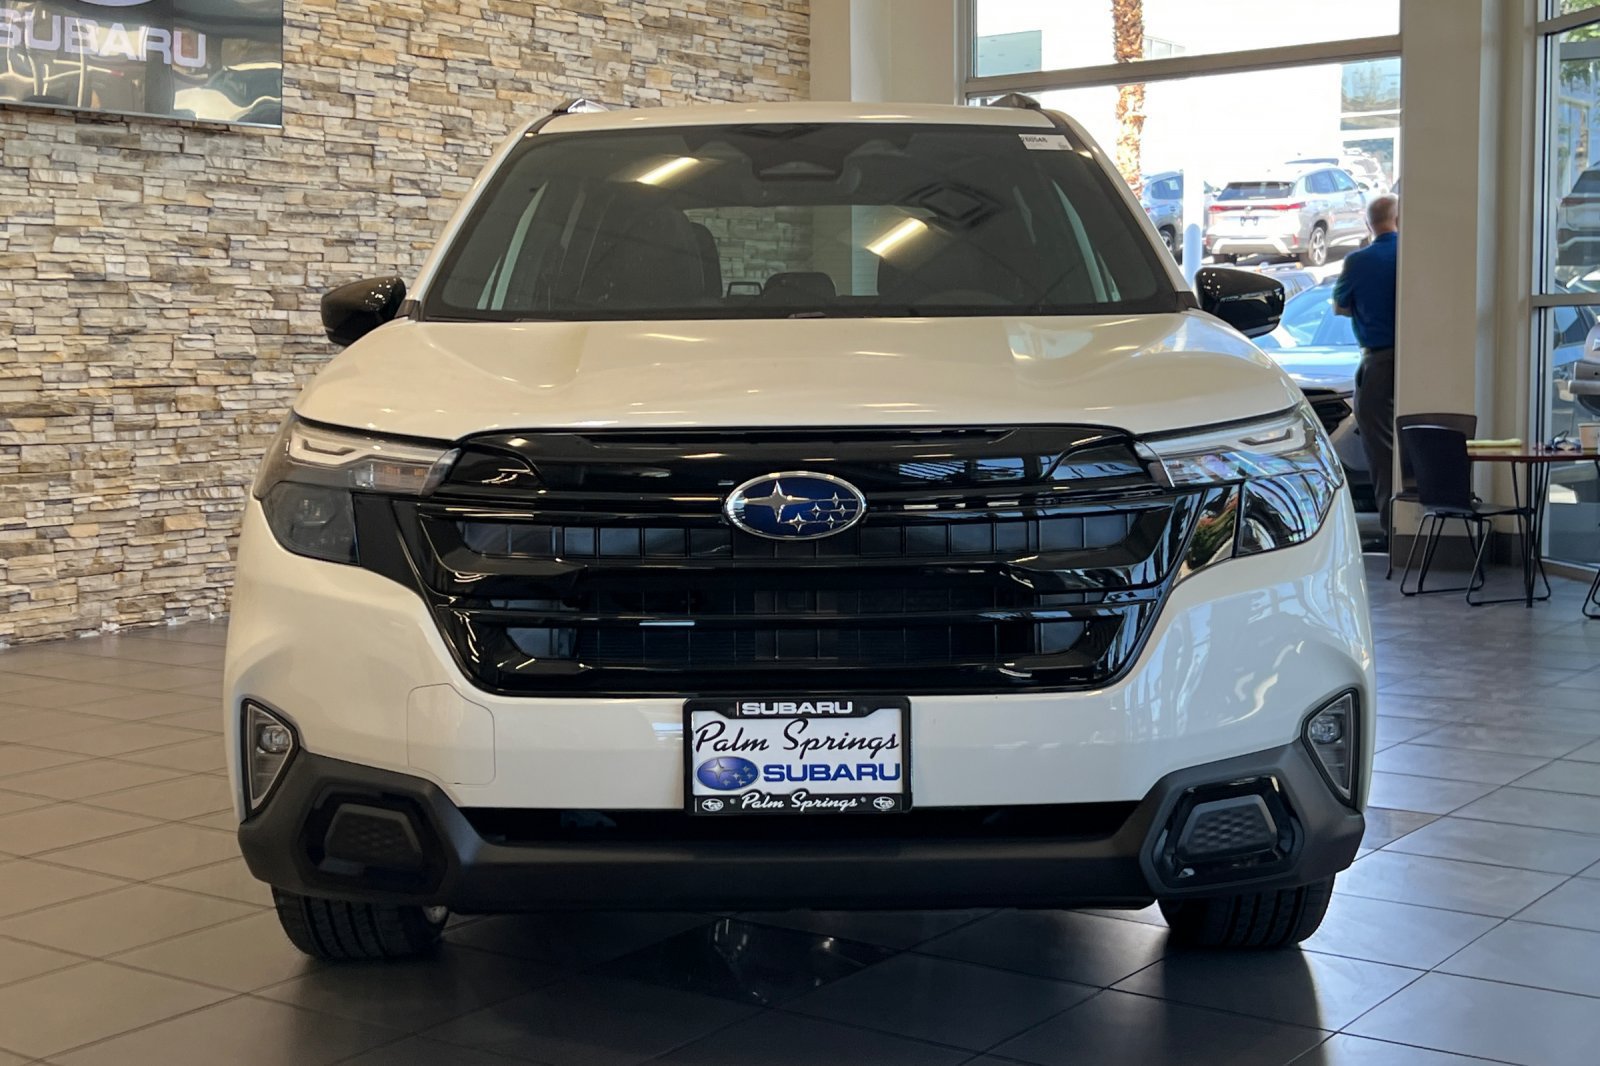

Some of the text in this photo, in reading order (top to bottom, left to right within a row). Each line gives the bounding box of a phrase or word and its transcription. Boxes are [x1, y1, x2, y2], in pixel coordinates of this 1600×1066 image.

[742, 701, 852, 714] SUBARU
[695, 717, 899, 759] Palm Springs
[763, 763, 900, 782] SUBARU
[741, 788, 857, 811] Palm Springs
